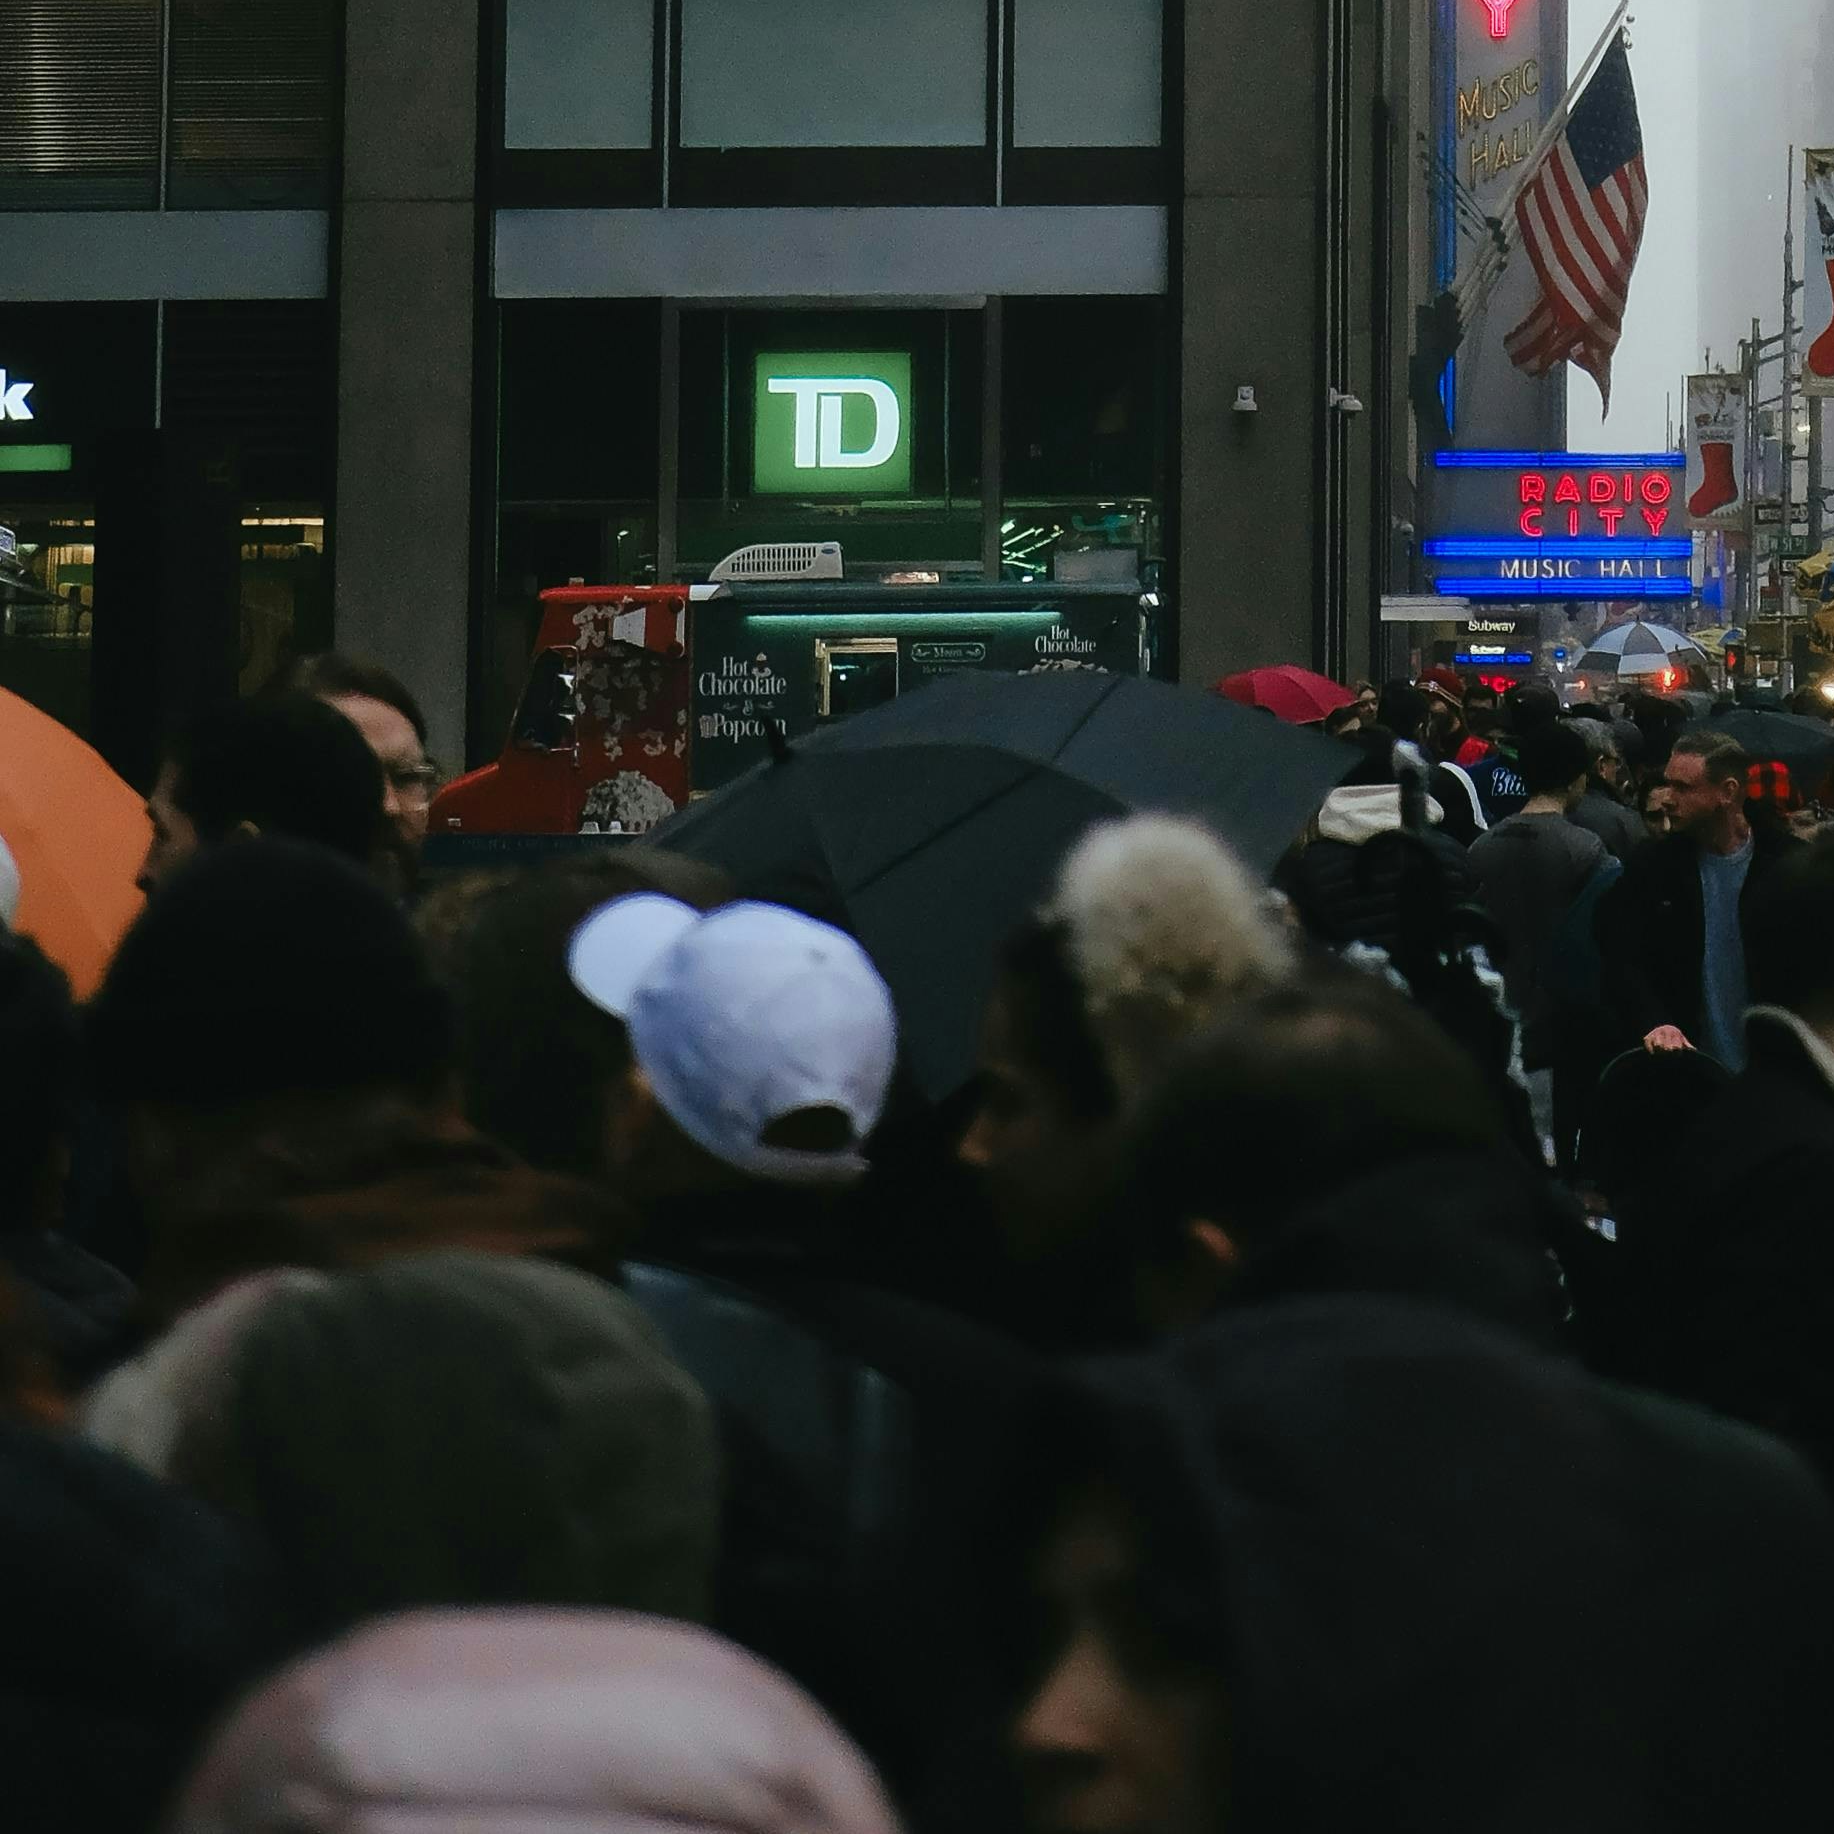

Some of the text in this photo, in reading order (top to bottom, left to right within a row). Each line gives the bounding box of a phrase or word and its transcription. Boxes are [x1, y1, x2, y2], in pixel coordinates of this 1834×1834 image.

[1458, 59, 1539, 137] MUSIC
[1468, 120, 1535, 189] HALL
[768, 377, 899, 469] TD
[1519, 473, 1672, 505] RADIO
[1519, 507, 1670, 538] CITY
[1500, 558, 1582, 580] MUSIC
[1051, 625, 1070, 641] Hot
[1467, 620, 1516, 634] Subway
[1034, 636, 1097, 654] Chocolate
[722, 656, 748, 678] Hot
[699, 671, 787, 696] Chocolate
[714, 713, 787, 744] Popcon
